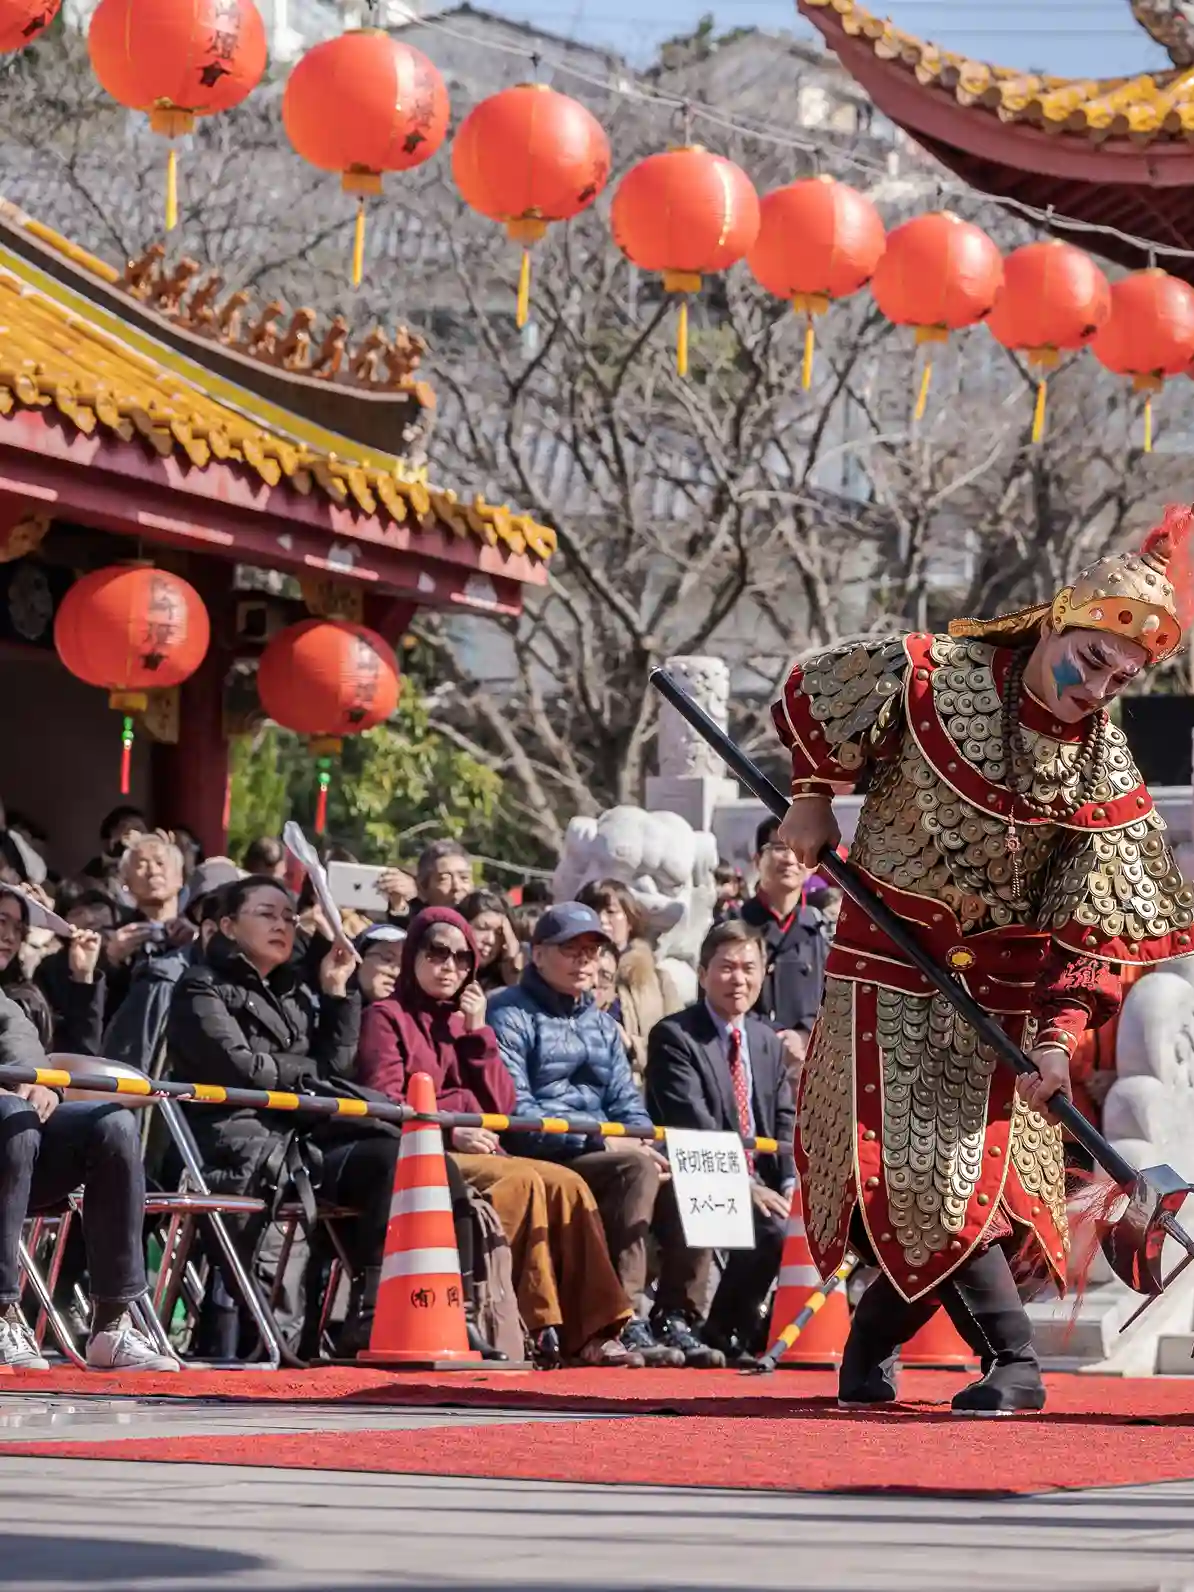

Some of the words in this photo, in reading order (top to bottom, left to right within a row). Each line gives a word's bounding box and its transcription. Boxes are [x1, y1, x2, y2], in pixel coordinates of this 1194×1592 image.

[675, 1147, 741, 1174] 貸切指定席
[689, 1194, 738, 1215] スペース
